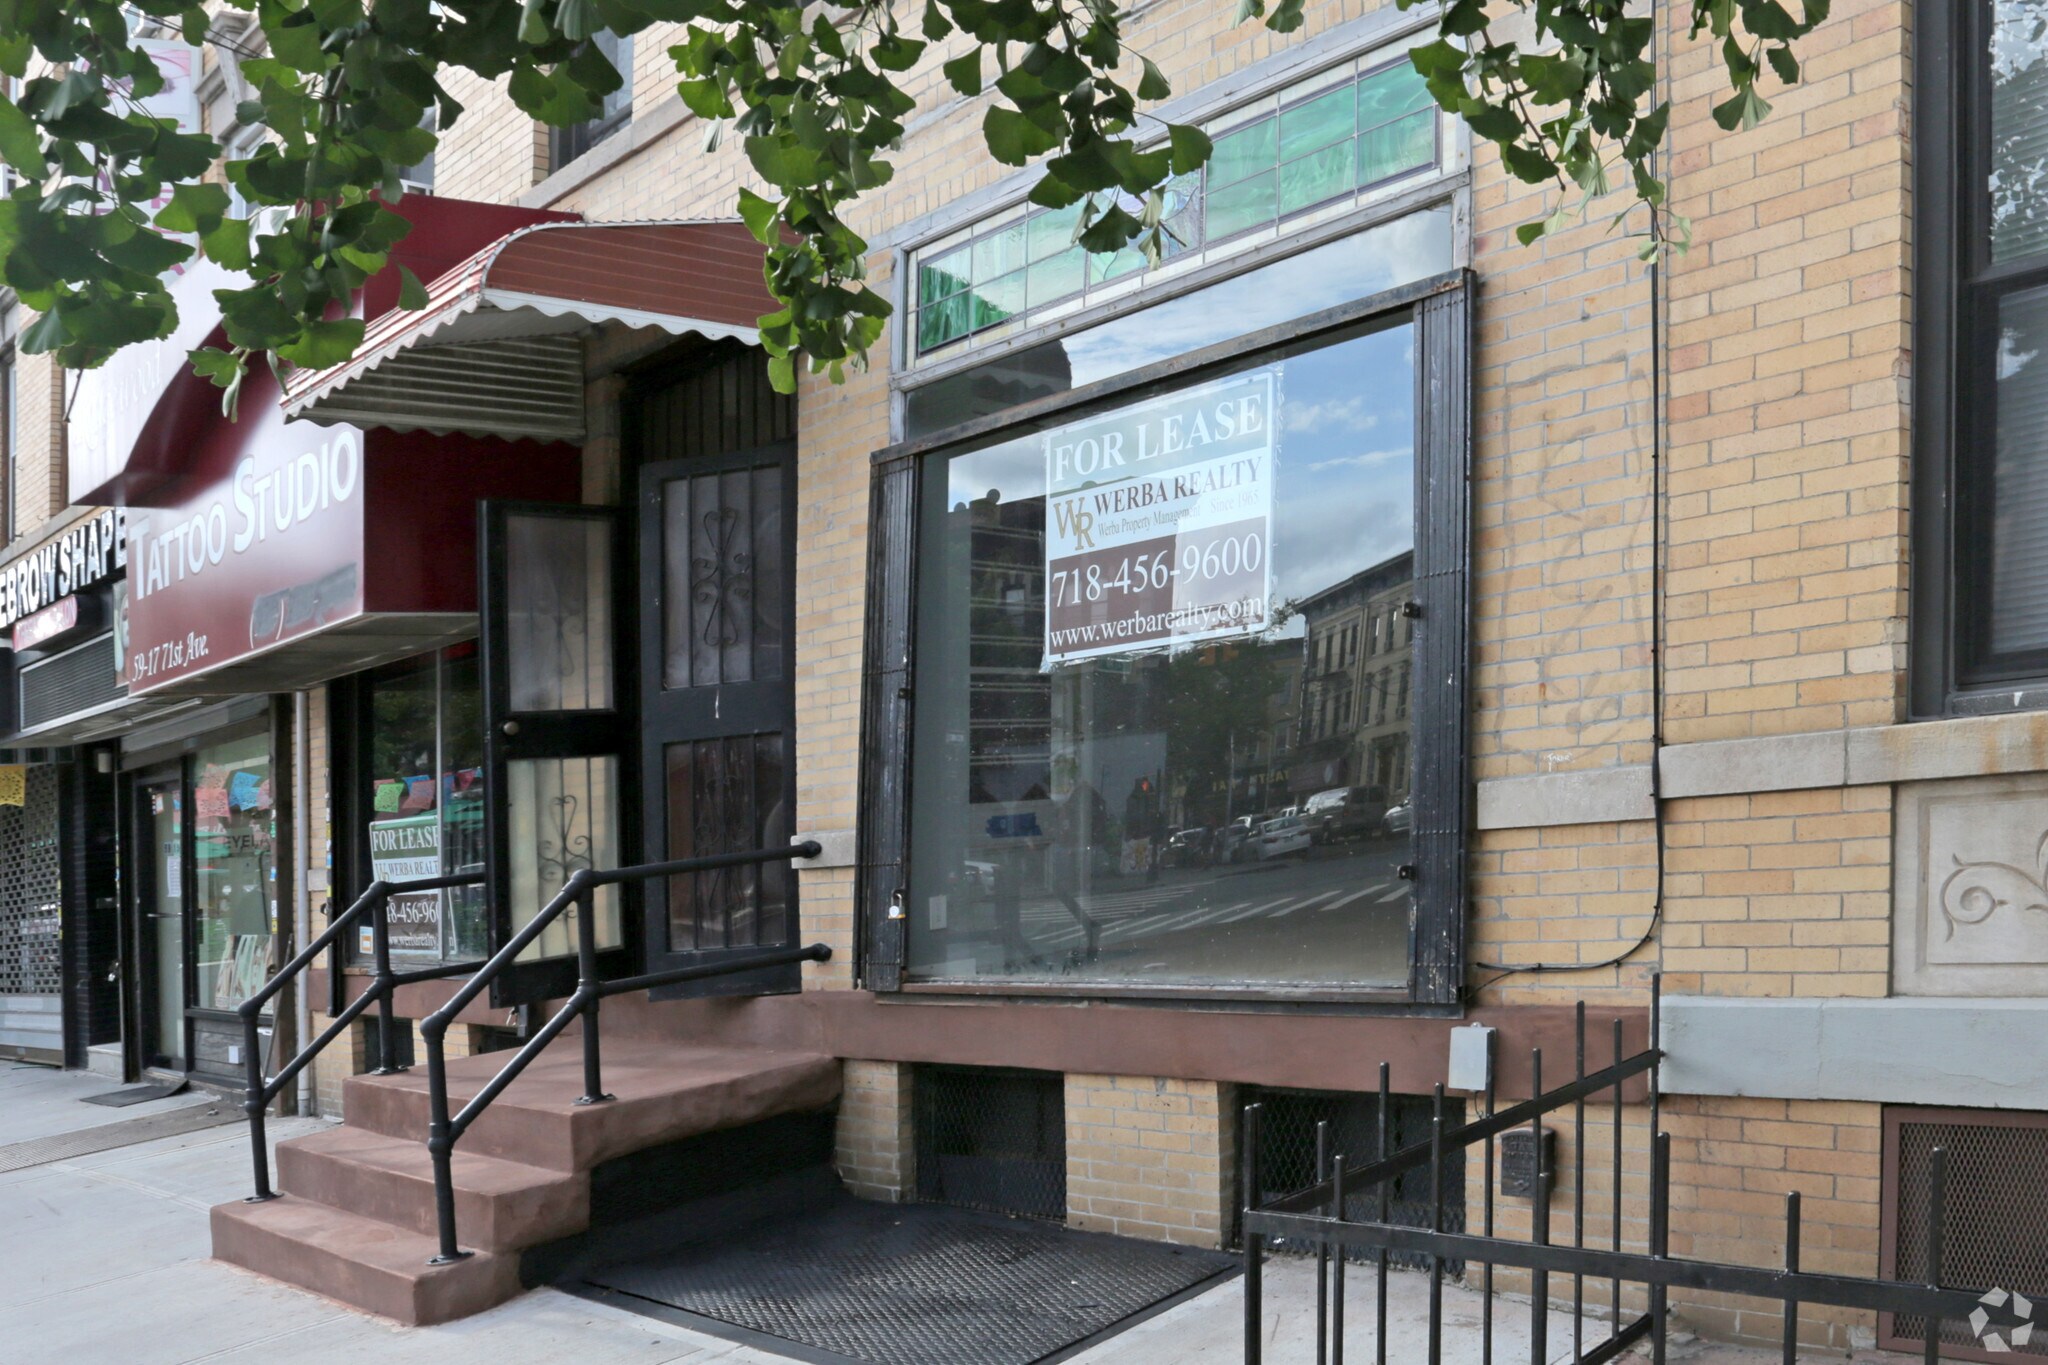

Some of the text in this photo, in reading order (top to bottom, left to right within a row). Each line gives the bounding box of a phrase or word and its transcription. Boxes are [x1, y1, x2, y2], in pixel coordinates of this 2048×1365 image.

[1054, 393, 1263, 483] FOR LEASE
[1094, 456, 1262, 516] WERBA REALTY
[1098, 520, 1120, 537] Werba
[1121, 514, 1151, 535] Property
[1153, 505, 1201, 525] Management
[1051, 533, 1262, 608] 718-456-9600
[1050, 597, 1262, 648] www.werbarealty.com
[132, 631, 209, 682] 59-17 71st Ave.
[372, 829, 397, 852] FOR
[388, 860, 439, 876] WERBA REALT
[386, 902, 440, 923] 18-456-96
